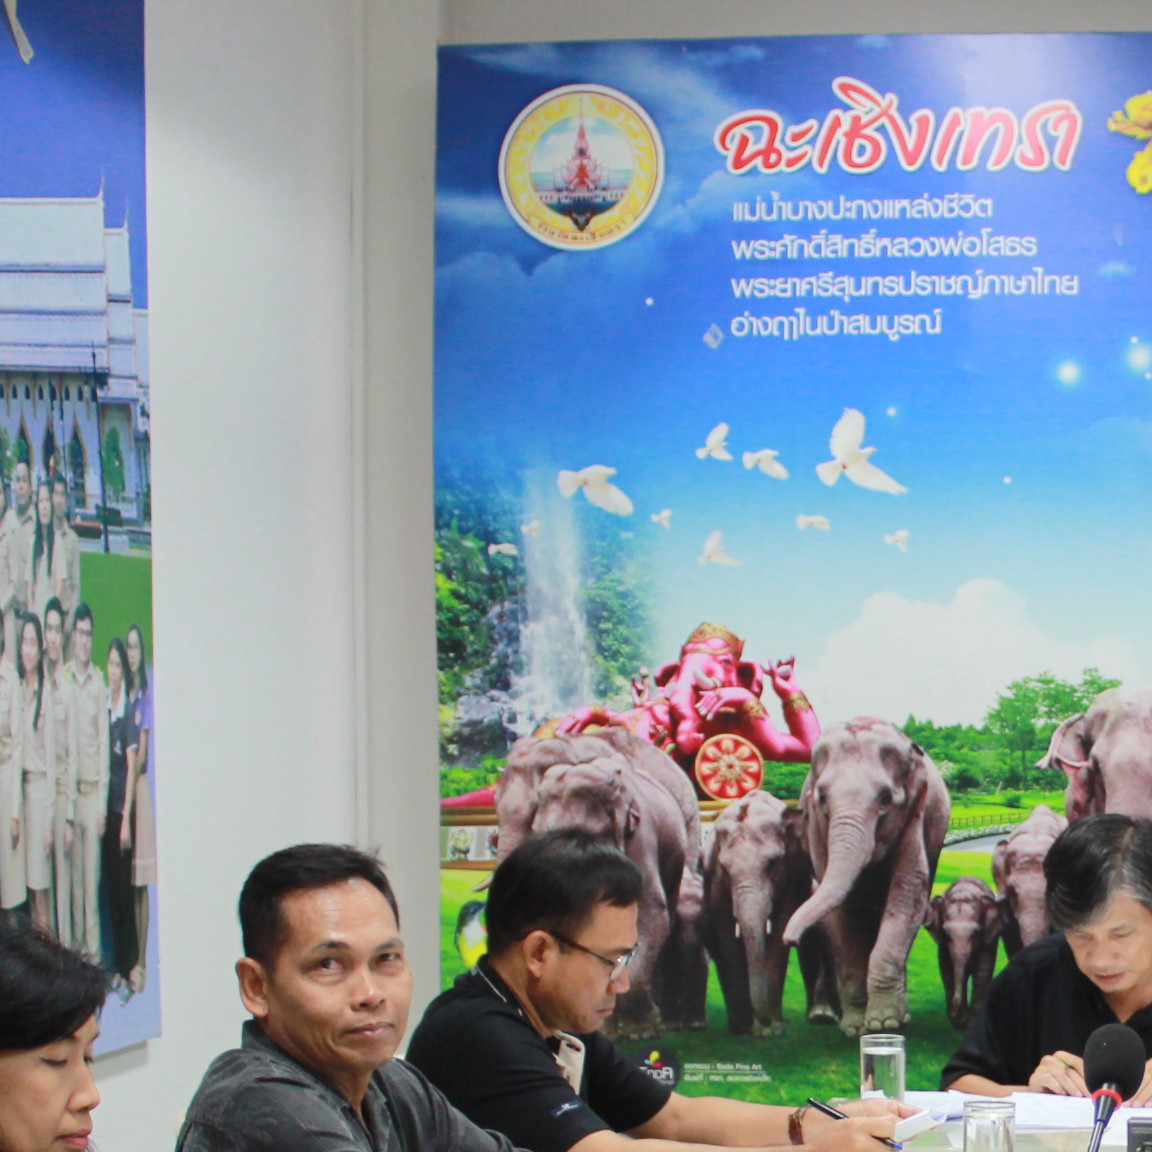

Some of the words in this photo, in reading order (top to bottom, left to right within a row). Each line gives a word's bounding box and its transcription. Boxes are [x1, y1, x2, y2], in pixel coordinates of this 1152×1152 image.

[714, 76, 1082, 174] ฉะเชิงเทรา
[732, 192, 994, 222] แม่น้ำบางปะกงแหล่งชีวิต
[731, 228, 1039, 260] พระศักดิ์สิทธิ์หลวงพ่อโสธร
[731, 267, 1080, 302] พระยาศรีสุนทรปราชญ์ภาษาไทย
